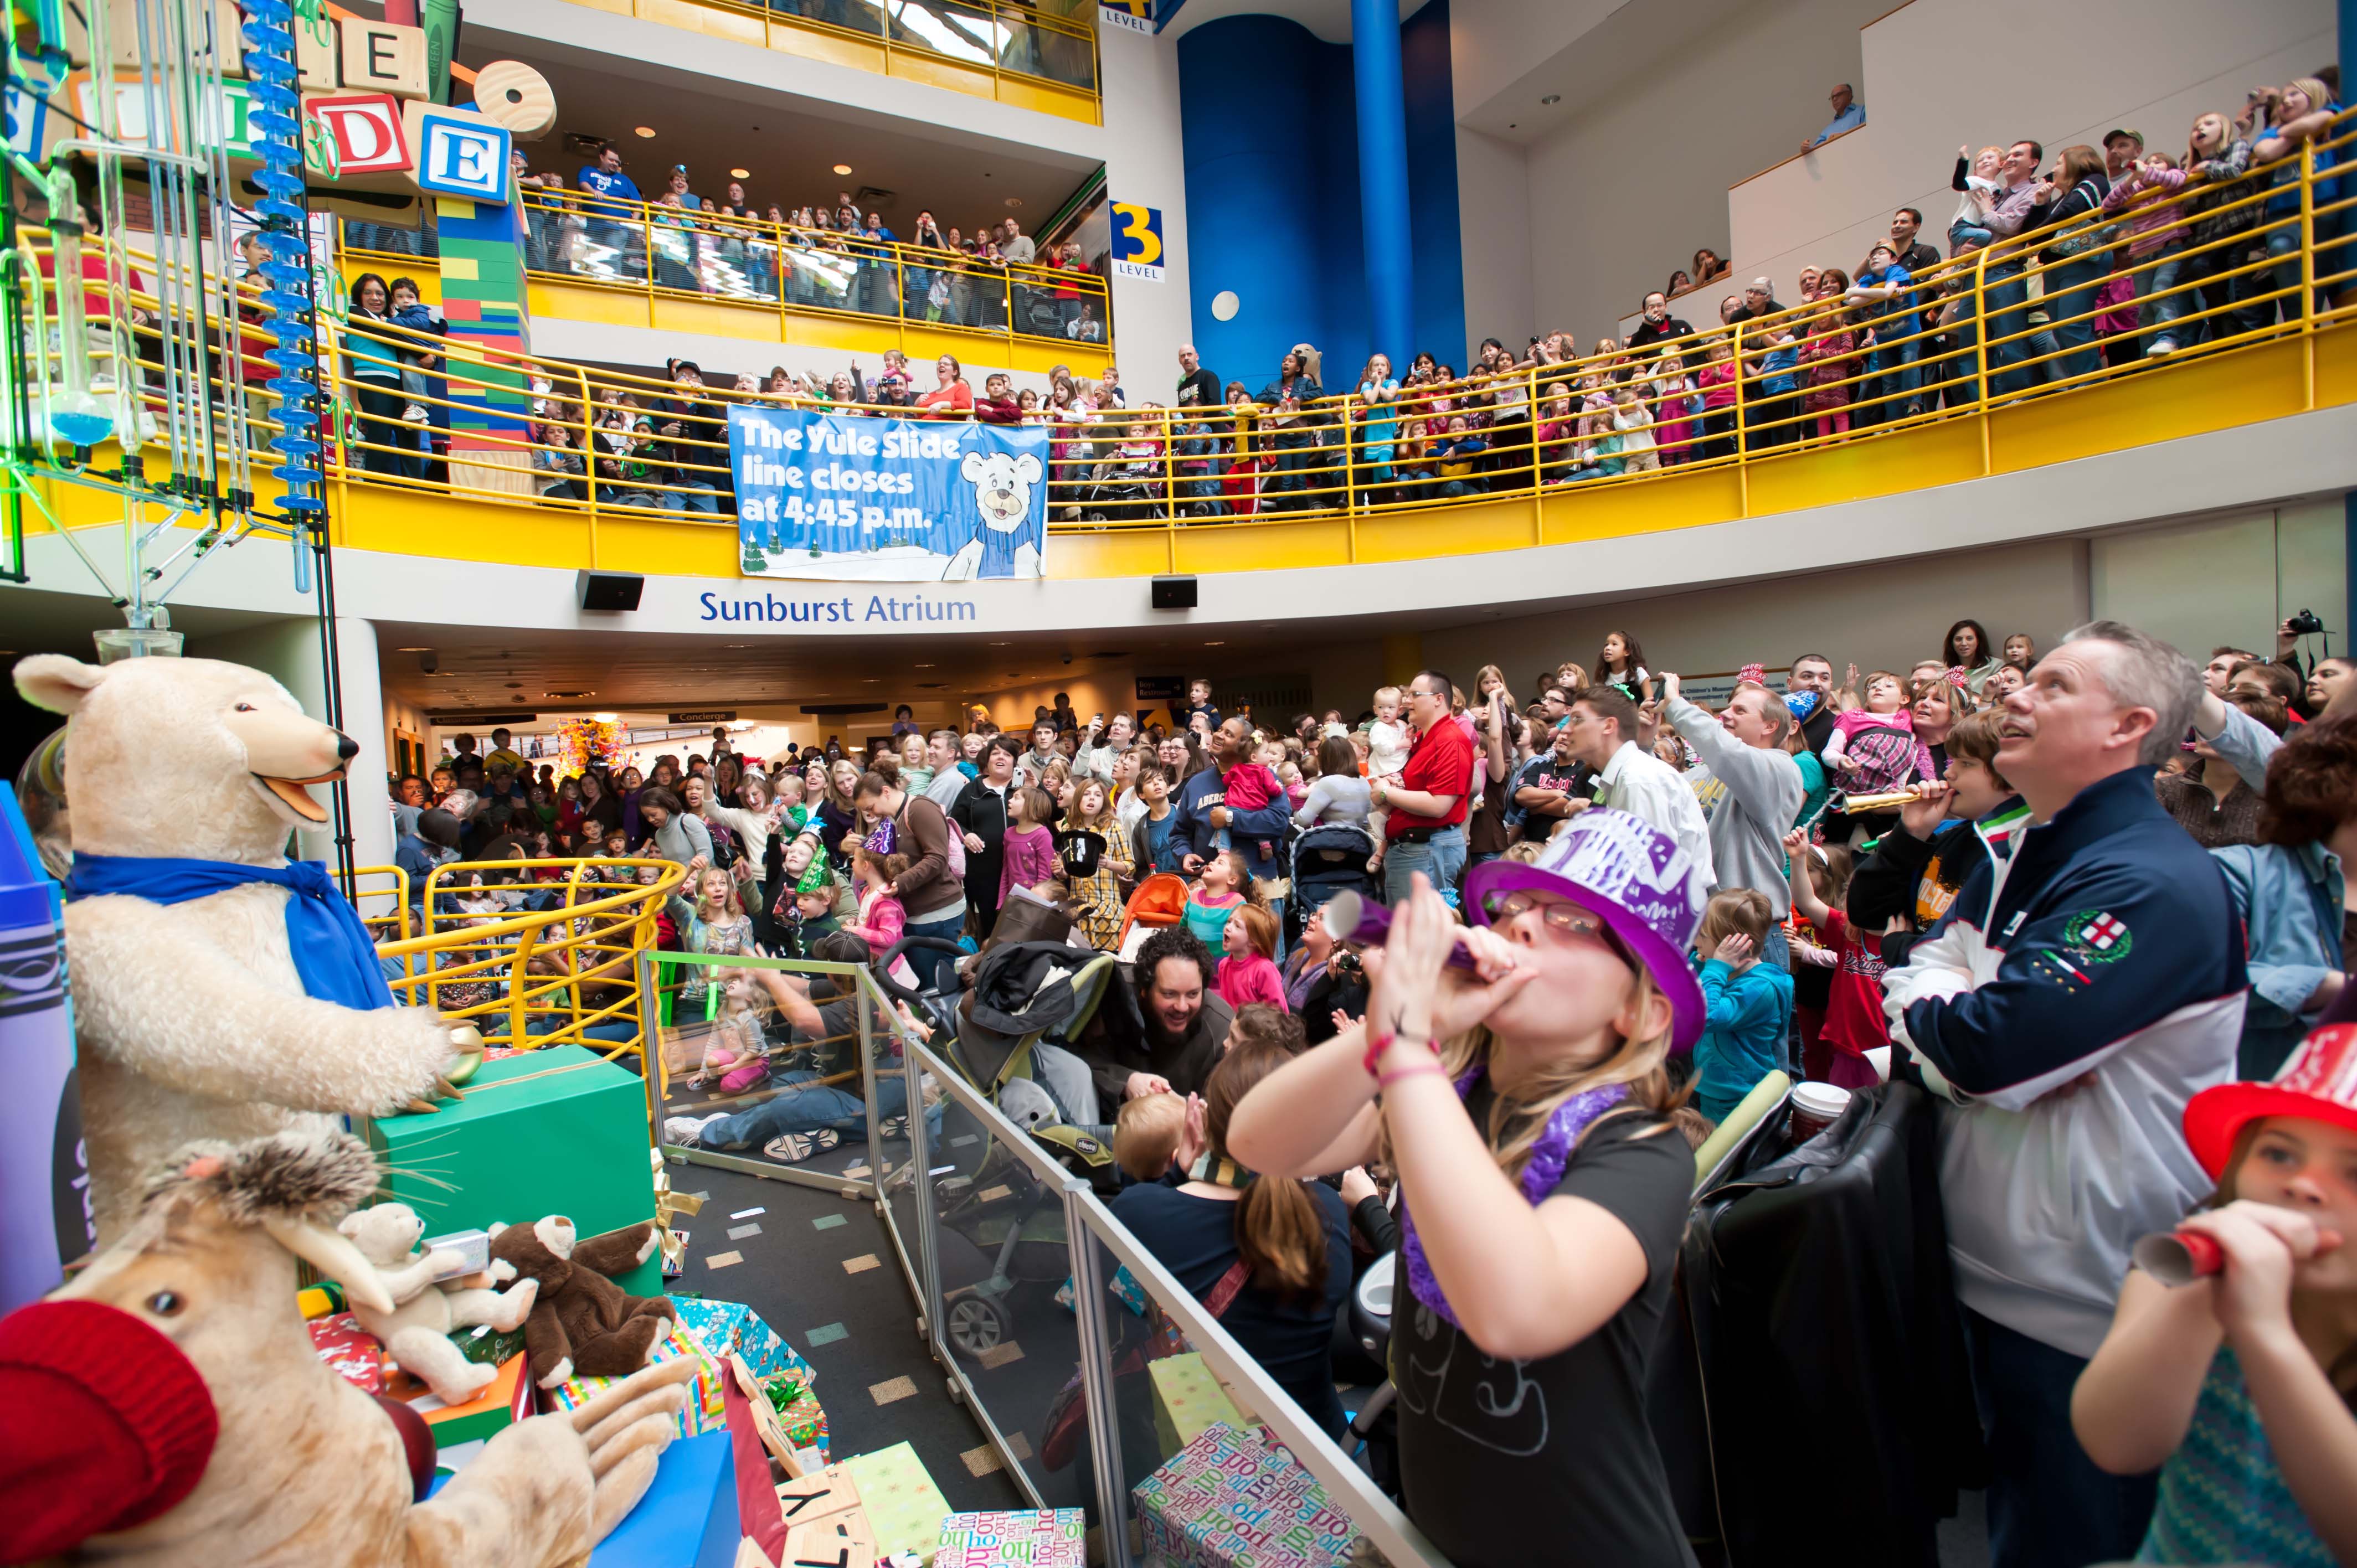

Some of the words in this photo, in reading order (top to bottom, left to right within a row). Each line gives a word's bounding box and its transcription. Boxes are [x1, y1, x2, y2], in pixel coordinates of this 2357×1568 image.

[1107, 10, 1145, 32] LEVEL
[429, 40, 441, 78] GREEN
[304, 118, 341, 182] 30
[1111, 202, 1162, 265] 3
[1119, 263, 1158, 279] LEVEL
[312, 264, 349, 323] 20
[326, 396, 358, 448] 10
[739, 417, 803, 451] The
[806, 425, 878, 457] Yule
[882, 430, 961, 460] Slide
[742, 455, 805, 489] line
[811, 462, 914, 494] closes
[742, 496, 780, 523] at
[784, 496, 858, 528] 4:45
[862, 506, 933, 534] p.m.
[700, 592, 855, 622] Sunburst
[864, 595, 976, 621] Atrium
[680, 712, 727, 722] Concierge
